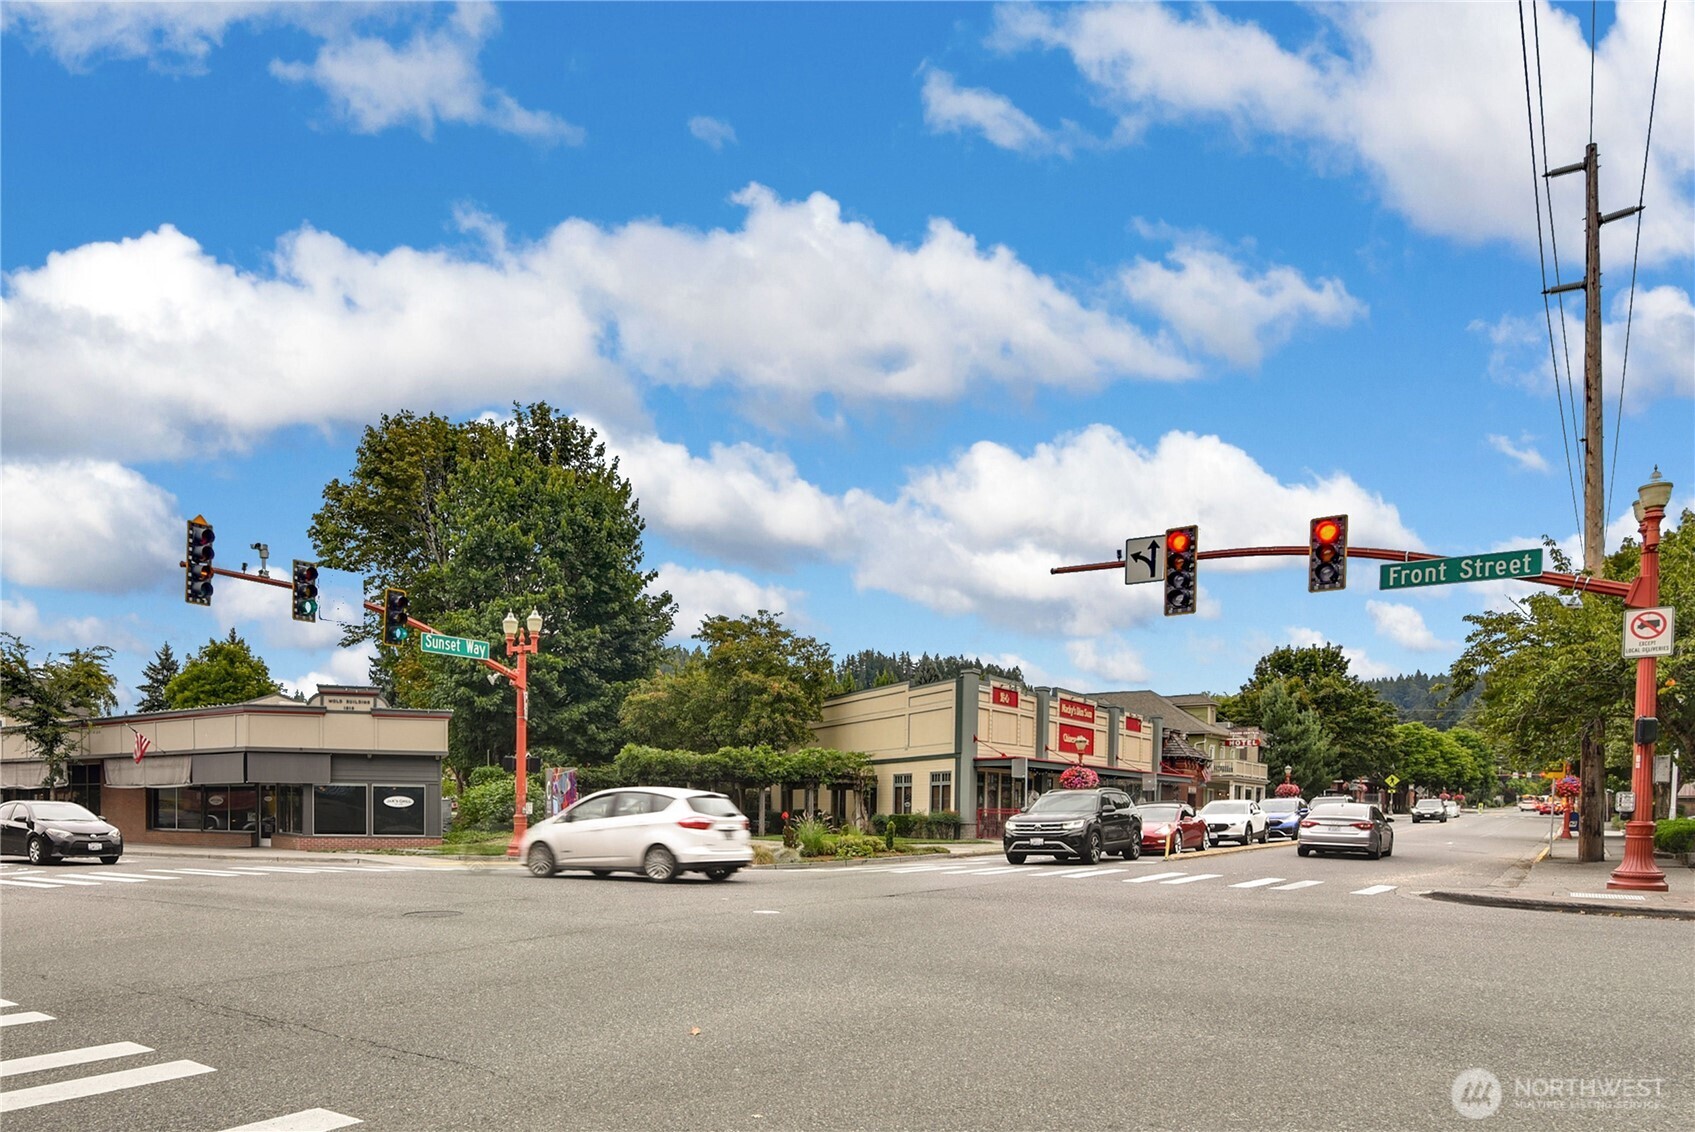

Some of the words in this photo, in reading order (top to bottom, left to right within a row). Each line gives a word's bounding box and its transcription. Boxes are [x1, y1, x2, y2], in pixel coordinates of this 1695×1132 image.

[1389, 562, 1447, 586] Front
[1459, 553, 1532, 579] Street
[425, 634, 461, 652] Sunset
[466, 640, 486, 659] Way
[1641, 645, 1670, 653] DELIVERIES
